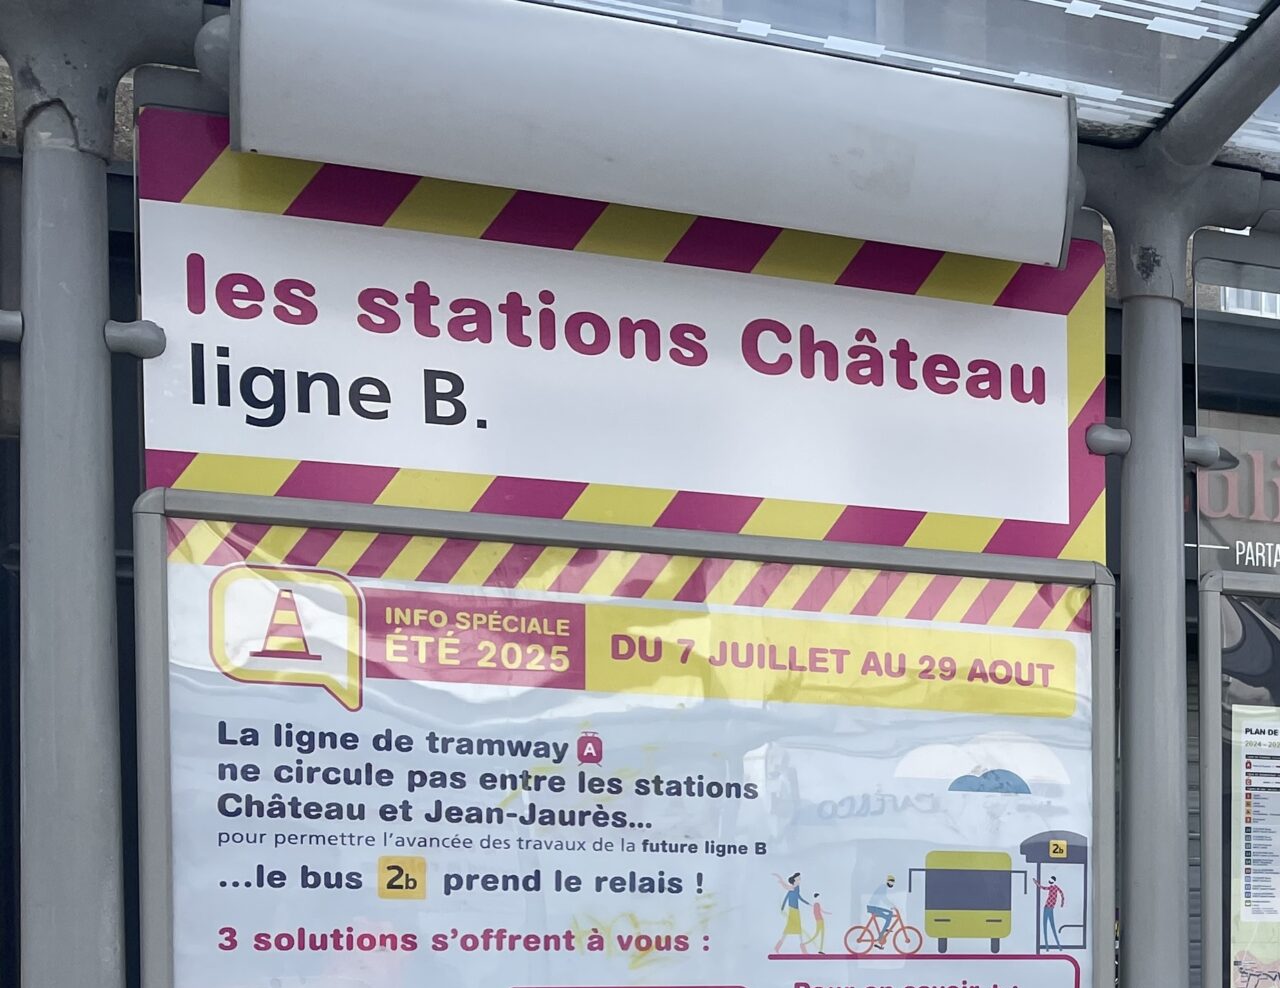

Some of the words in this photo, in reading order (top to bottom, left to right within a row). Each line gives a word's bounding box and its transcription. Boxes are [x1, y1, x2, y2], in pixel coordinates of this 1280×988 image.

[186, 253, 318, 325] les
[357, 279, 709, 368] stations
[741, 317, 1047, 405] Château
[191, 343, 391, 428] ligne
[423, 368, 488, 431] B.
[385, 608, 448, 629] INFO
[456, 608, 570, 637] SPÉCIALE
[385, 628, 462, 667] ÉTÉ
[477, 641, 570, 672] 2025
[611, 634, 662, 663] DU
[676, 638, 693, 664] 7
[709, 641, 850, 674] JUILLET
[861, 651, 905, 679] AU
[918, 654, 956, 681] 29
[967, 660, 1054, 687] AOUT
[218, 722, 258, 747] La
[274, 722, 359, 756] ligne
[372, 729, 414, 753] de
[426, 731, 569, 764] tramway
[218, 763, 260, 782] ne
[273, 761, 393, 788] circule
[408, 768, 467, 794] pas
[479, 771, 566, 794] entre
[579, 771, 623, 796] les
[635, 775, 758, 800] stations
[218, 793, 364, 821] Château
[379, 799, 413, 823] et
[218, 830, 267, 850] pour
[274, 832, 375, 851] permettre
[383, 832, 473, 850] l'avancée
[480, 834, 510, 850] des
[516, 837, 586, 853] travaux
[593, 836, 615, 852] de
[620, 837, 636, 853] la
[642, 838, 698, 854] future
[704, 840, 748, 858] ligne
[755, 841, 766, 855] B
[301, 866, 362, 889] bus
[385, 866, 417, 890] 2b
[442, 868, 541, 899] prend
[554, 871, 581, 893] le
[595, 872, 683, 895] relais
[218, 929, 238, 950] 3
[254, 928, 418, 952] solutions
[432, 928, 574, 953] s'offrent
[587, 928, 604, 953] à
[618, 933, 689, 952] vous
